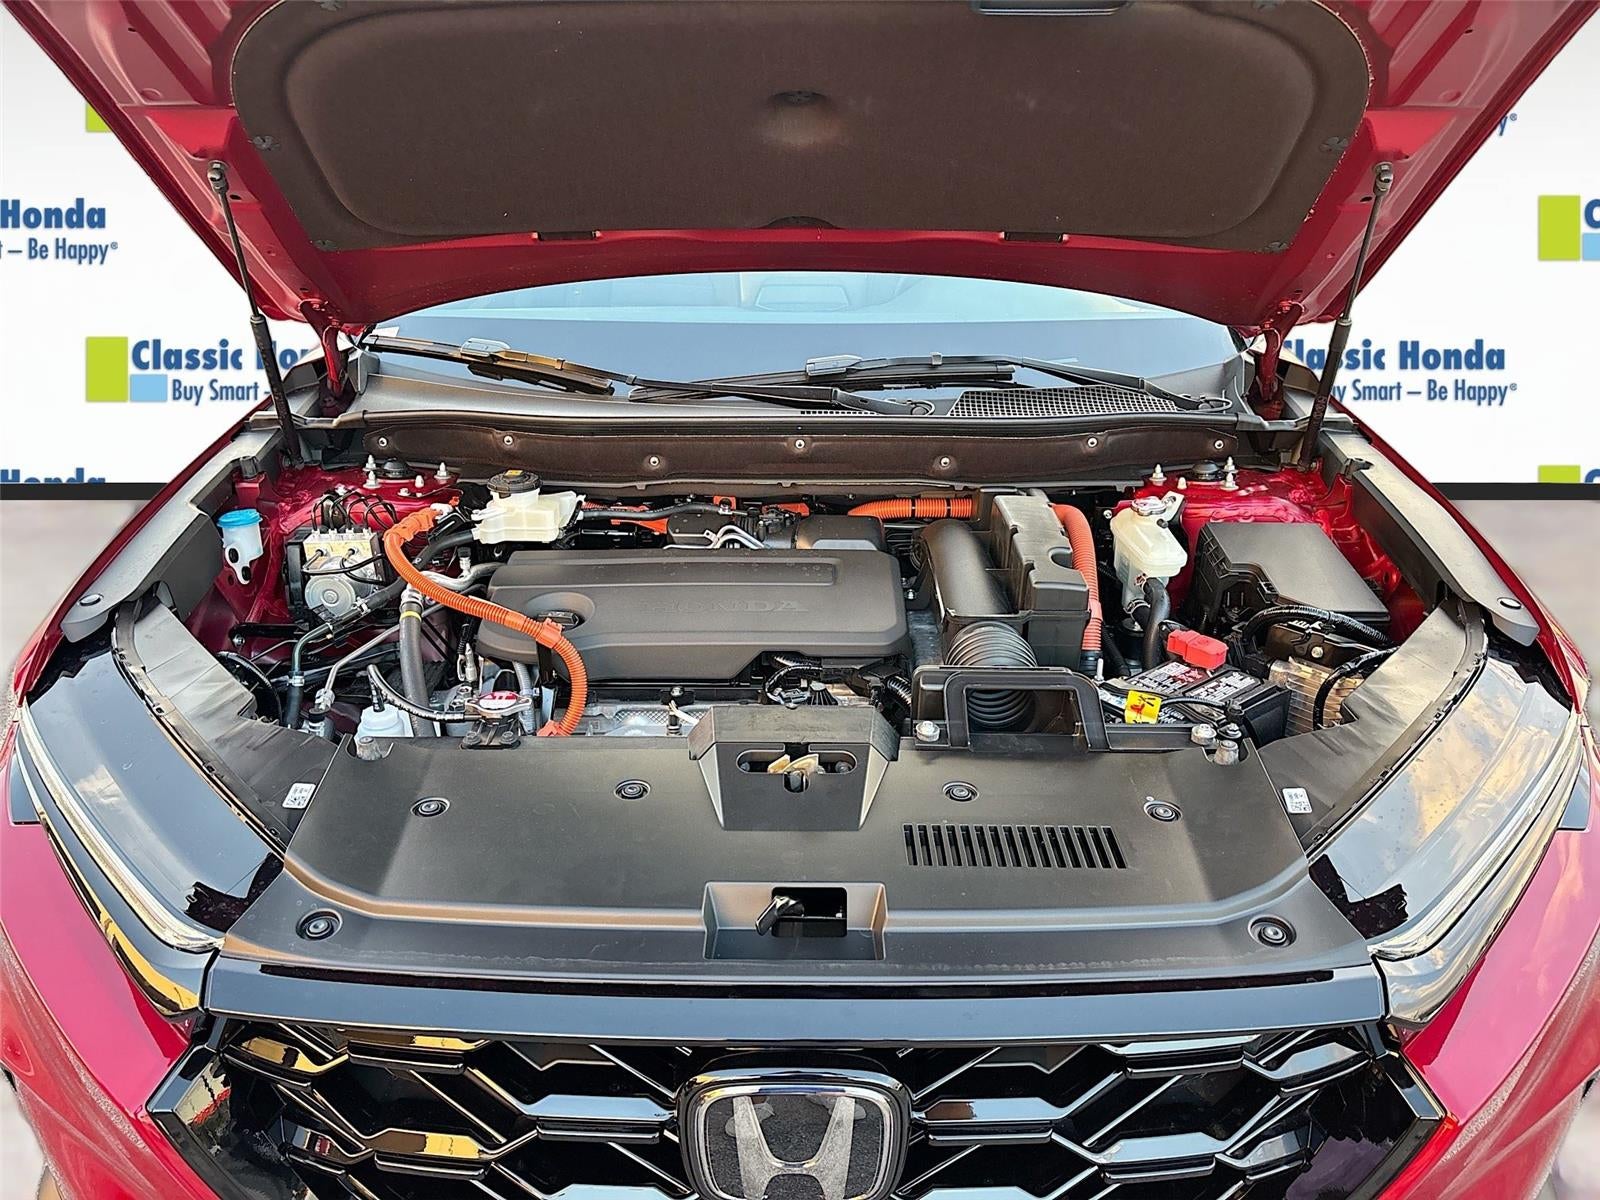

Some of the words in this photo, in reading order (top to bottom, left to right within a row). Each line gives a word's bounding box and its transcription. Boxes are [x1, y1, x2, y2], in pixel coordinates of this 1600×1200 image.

[0, 197, 106, 229] Honda
[28, 237, 48, 260] Be
[132, 338, 243, 370] Classic
[1400, 338, 1506, 370] Honda
[172, 378, 204, 406] Buy
[209, 378, 260, 402] Smart
[1353, 378, 1403, 402] Smart
[1427, 378, 1448, 401] Be
